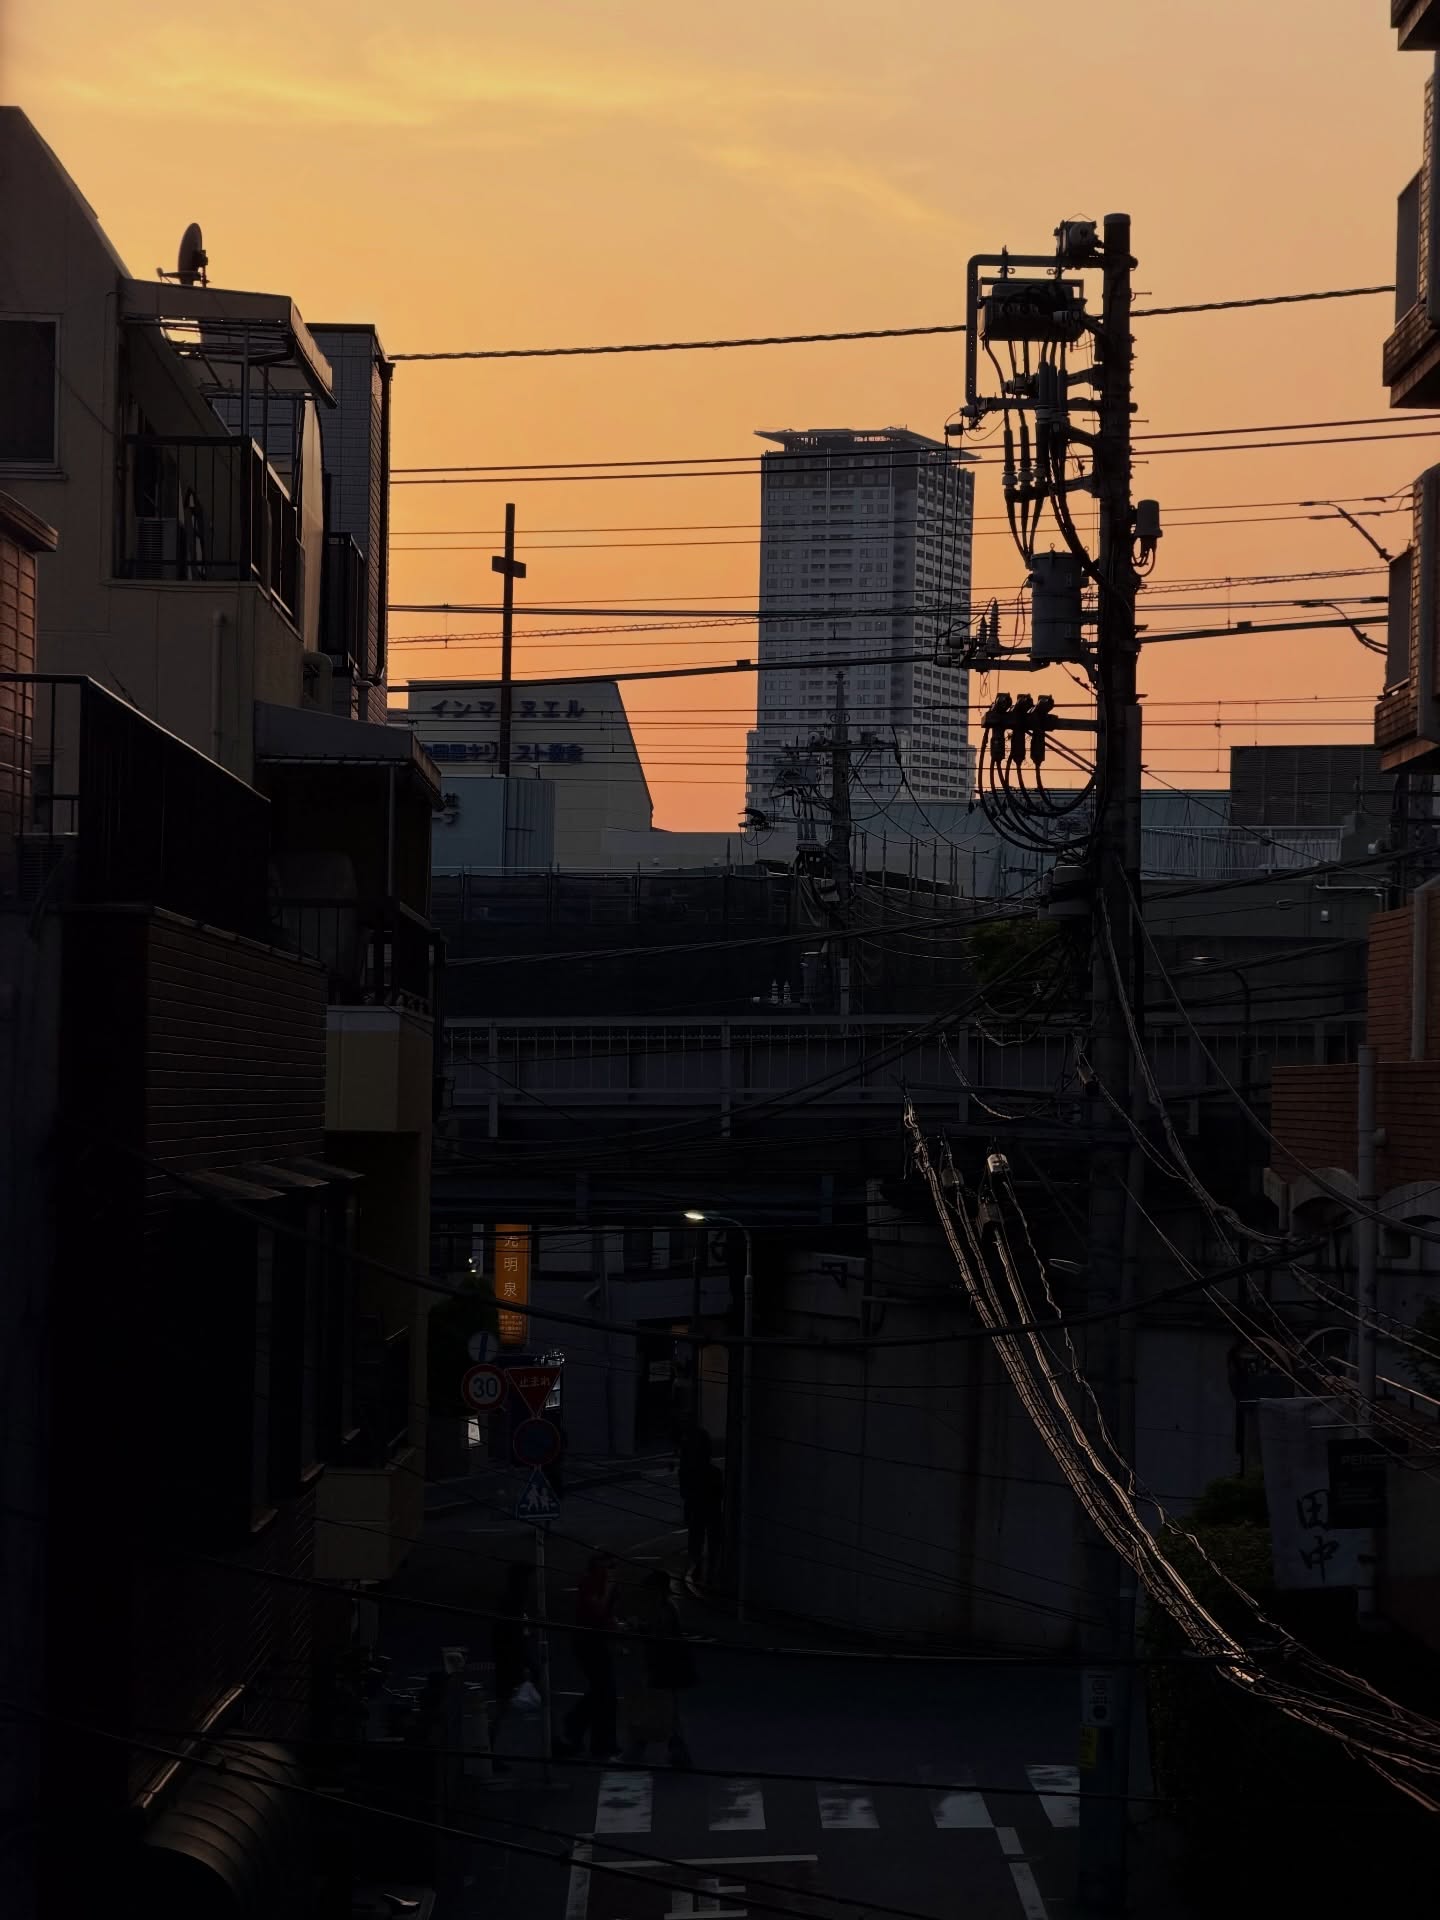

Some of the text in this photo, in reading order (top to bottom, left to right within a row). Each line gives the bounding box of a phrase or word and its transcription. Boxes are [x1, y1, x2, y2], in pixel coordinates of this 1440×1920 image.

[431, 699, 585, 719] インマヌエル
[473, 1377, 498, 1398] 30
[518, 1375, 551, 1388] 止まれ
[1296, 1489, 1339, 1583] 田中
